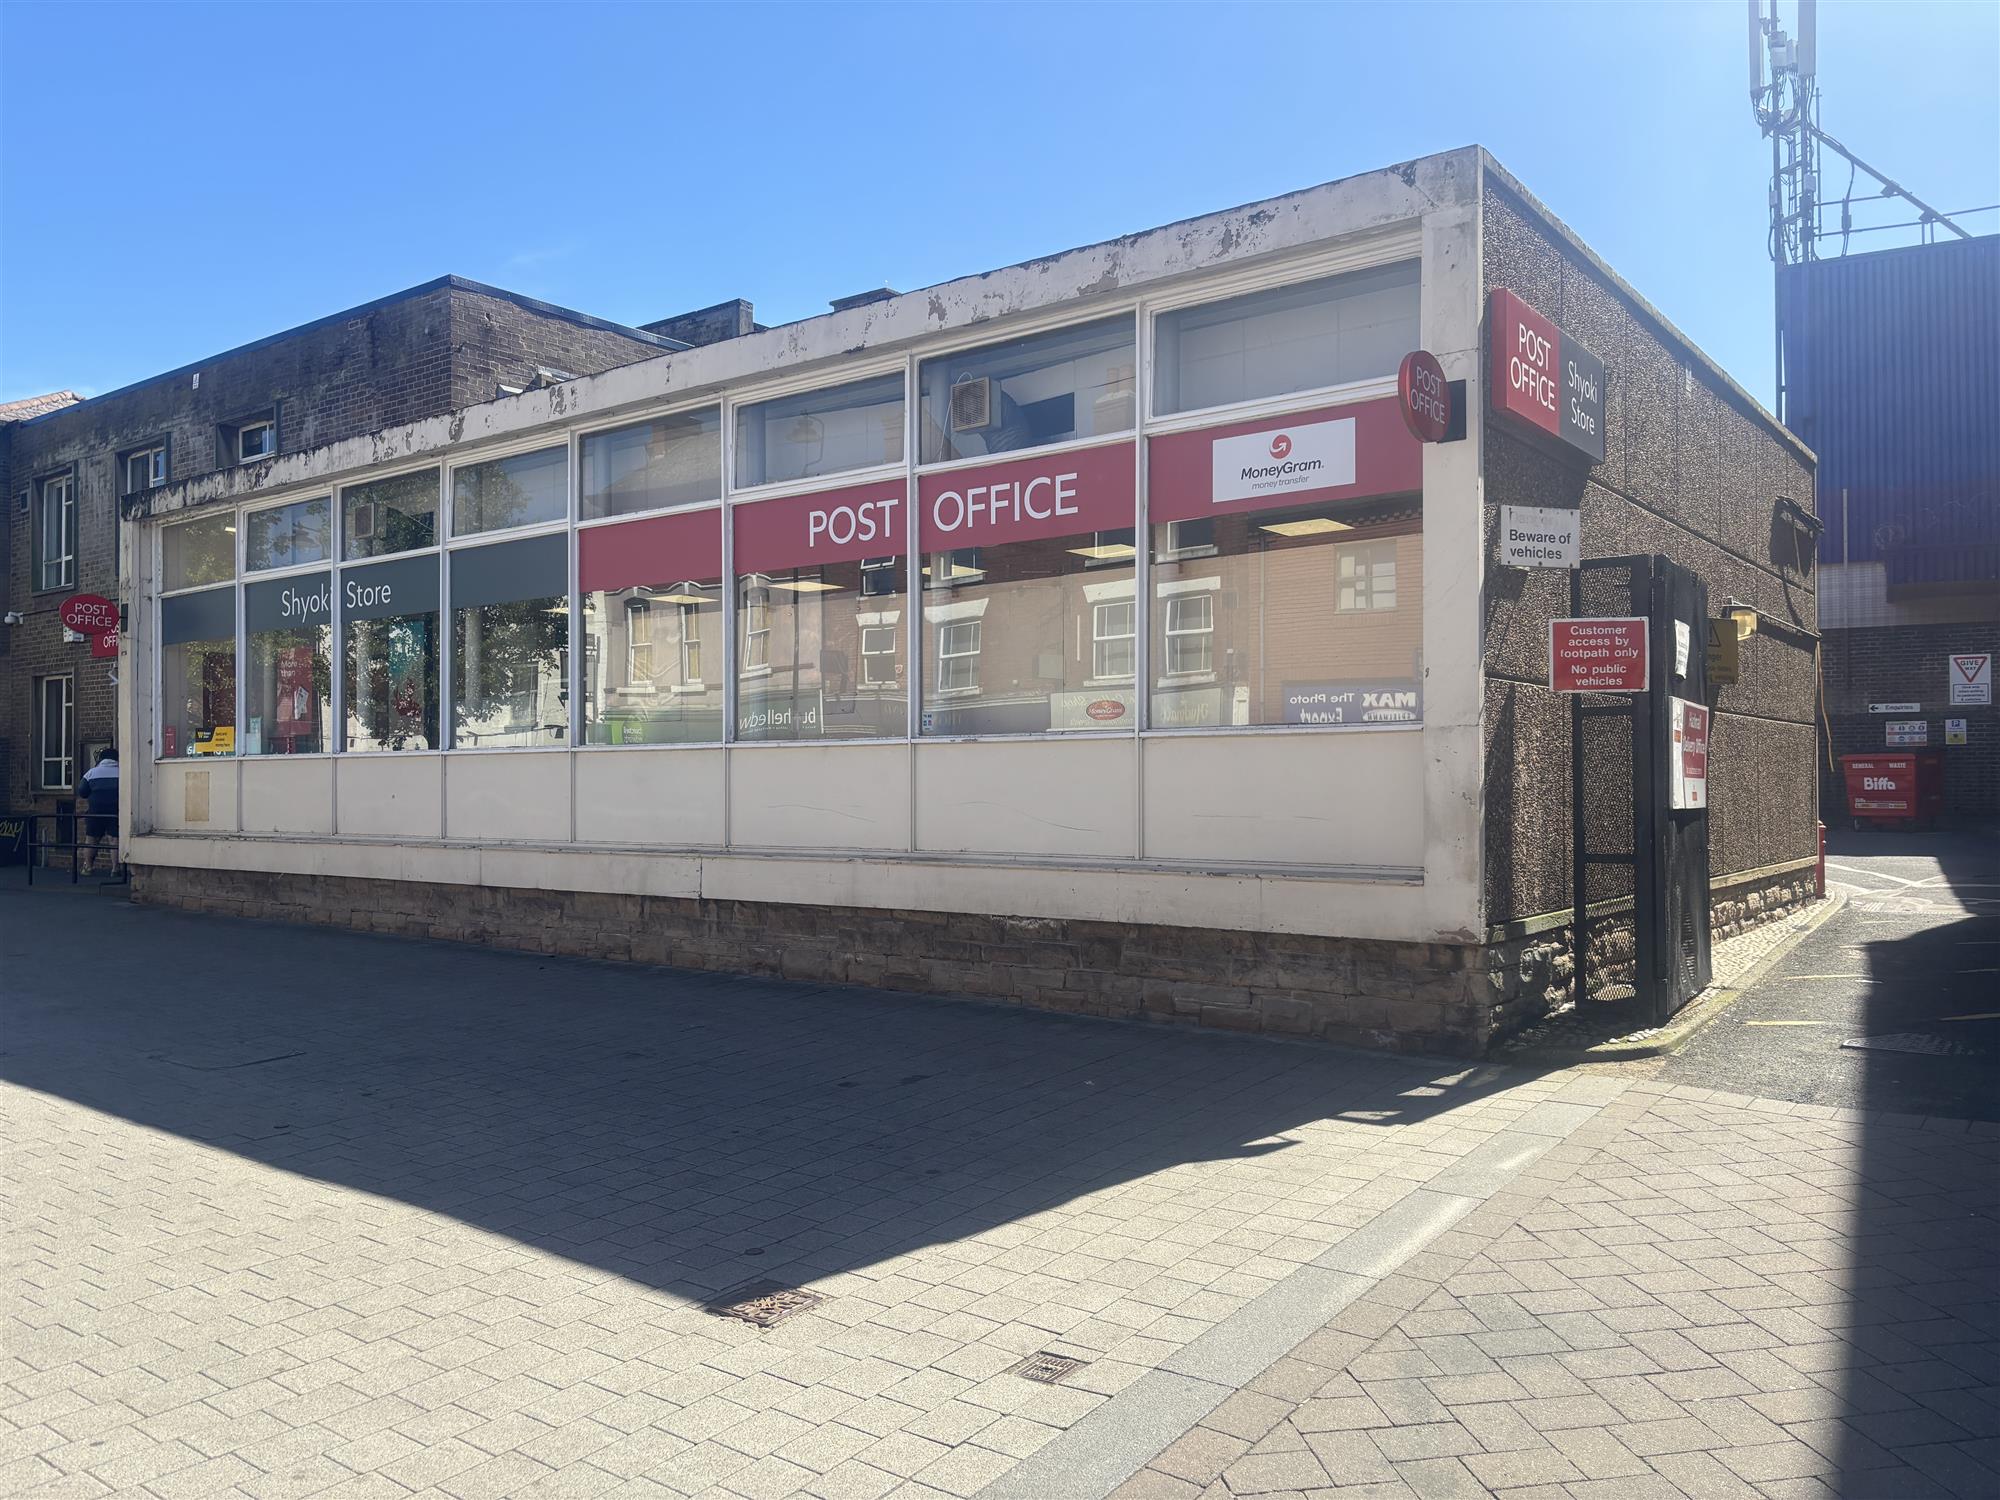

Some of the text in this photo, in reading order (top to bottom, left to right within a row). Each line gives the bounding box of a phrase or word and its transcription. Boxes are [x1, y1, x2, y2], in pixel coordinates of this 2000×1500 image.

[1519, 323, 1552, 371] POST
[1416, 366, 1442, 397] POST
[1510, 357, 1556, 412] OFFICE
[1568, 360, 1598, 405] Shyoki
[1410, 389, 1446, 424] OFFICE
[1571, 397, 1595, 435] Store
[1251, 475, 1310, 490] money transfer
[809, 472, 1079, 547] POST OFFICE
[1509, 529, 1572, 544] Beware of
[1510, 546, 1562, 560] vehicles
[346, 581, 392, 609] Store
[75, 603, 108, 616] POST
[66, 614, 112, 627] OFFICE
[1570, 625, 1627, 635] Customer
[1568, 636, 1629, 646] access by
[1560, 647, 1639, 659] footpath only
[1571, 663, 1627, 675] No public
[1575, 677, 1623, 686] vehicles
[1864, 777, 1896, 790] Biffa
